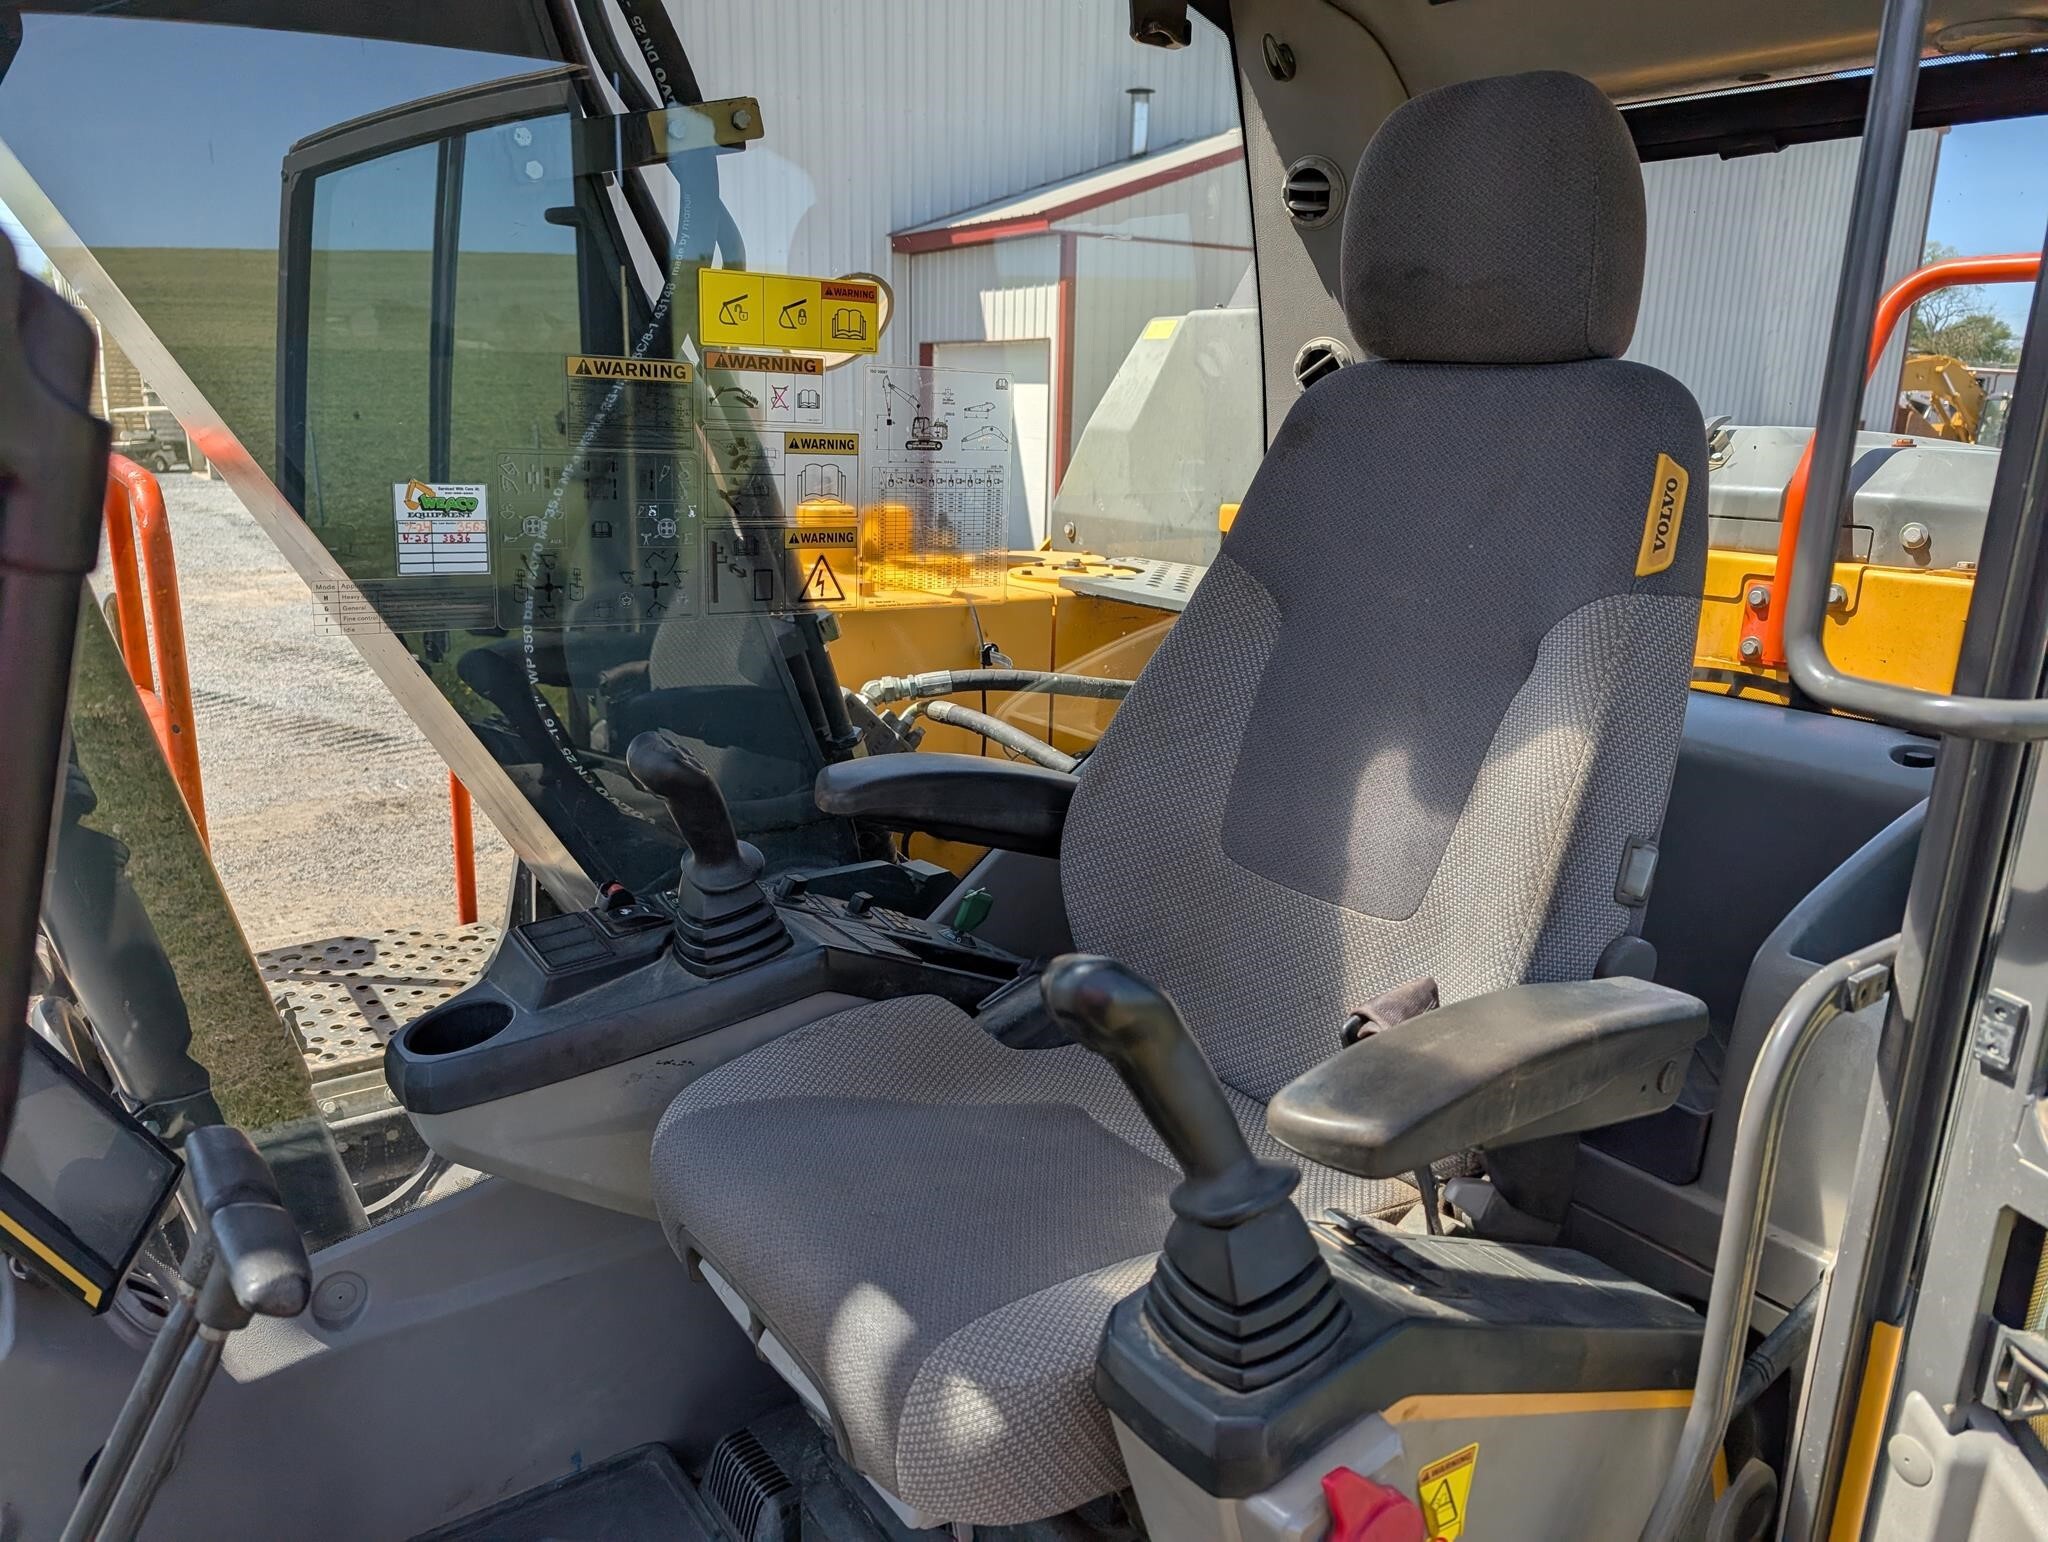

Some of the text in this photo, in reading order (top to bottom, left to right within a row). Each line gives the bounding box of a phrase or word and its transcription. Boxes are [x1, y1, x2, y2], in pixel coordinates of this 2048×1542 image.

[630, 15, 647, 36] 25
[640, 37, 660, 63] DN
[834, 287, 876, 301] WARNING
[593, 360, 688, 380] WARNING
[728, 354, 817, 374] WARNING
[800, 438, 855, 451] WARNING
[407, 511, 473, 520] EQUIPMENT
[1652, 477, 1679, 555] VOLVO
[800, 531, 855, 544] WARNING
[522, 595, 535, 621] bar
[523, 624, 535, 654] 350
[525, 658, 541, 685] WP
[543, 718, 562, 742] -16
[561, 746, 578, 767] 25
